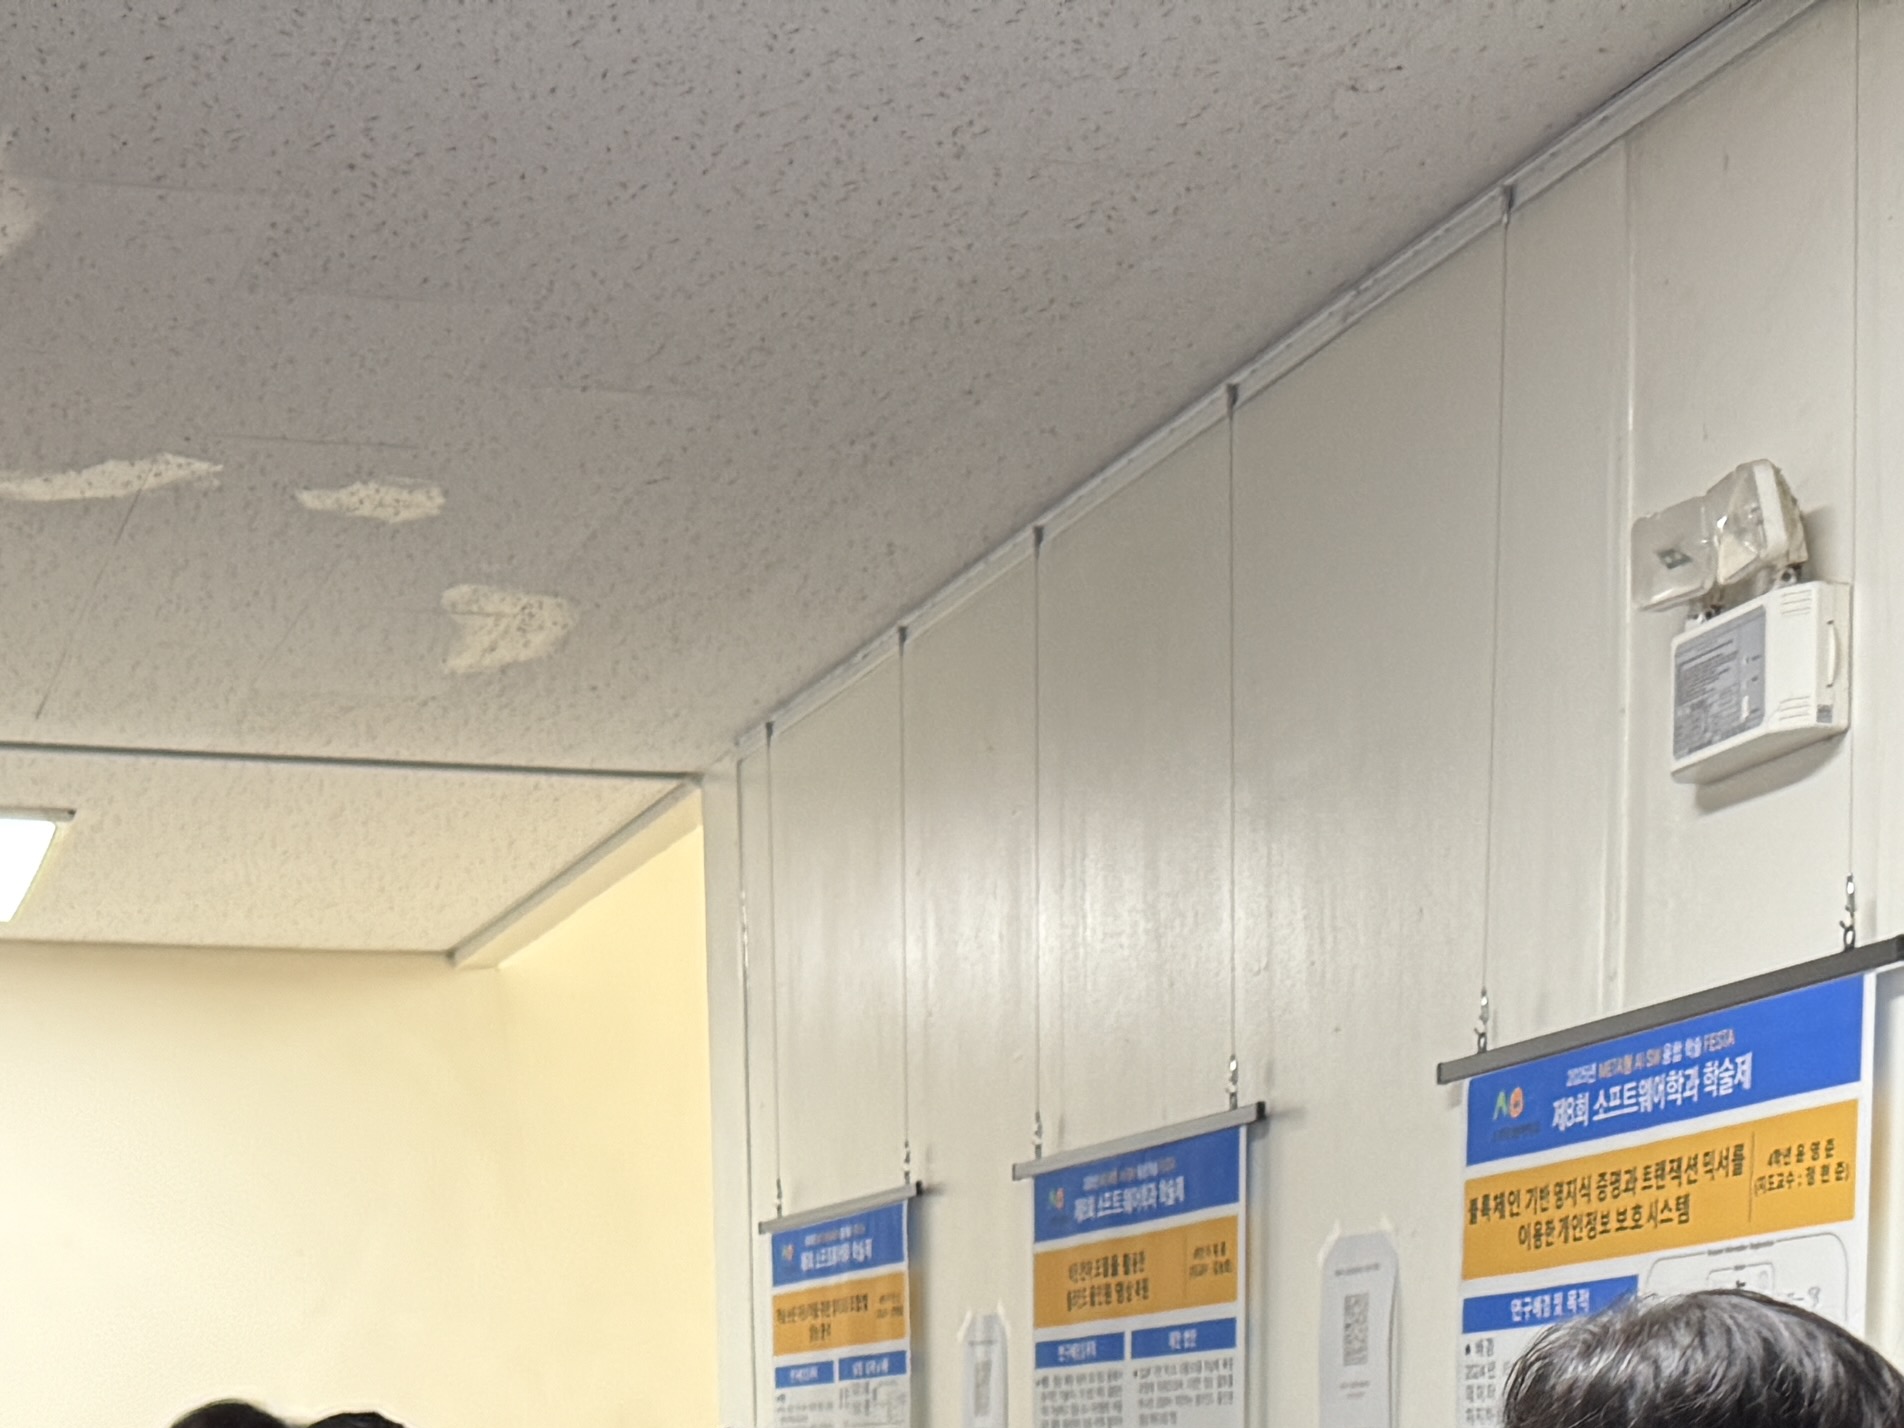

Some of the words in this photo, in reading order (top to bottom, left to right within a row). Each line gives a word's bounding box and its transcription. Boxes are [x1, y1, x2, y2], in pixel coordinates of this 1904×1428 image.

[1592, 1065, 1700, 1121] 소프트웨어학과
[1703, 1051, 1753, 1098] 학술제
[1524, 1181, 1550, 1215] 기반
[1614, 1203, 1644, 1232] 보호
[1647, 1193, 1691, 1229] 시스템
